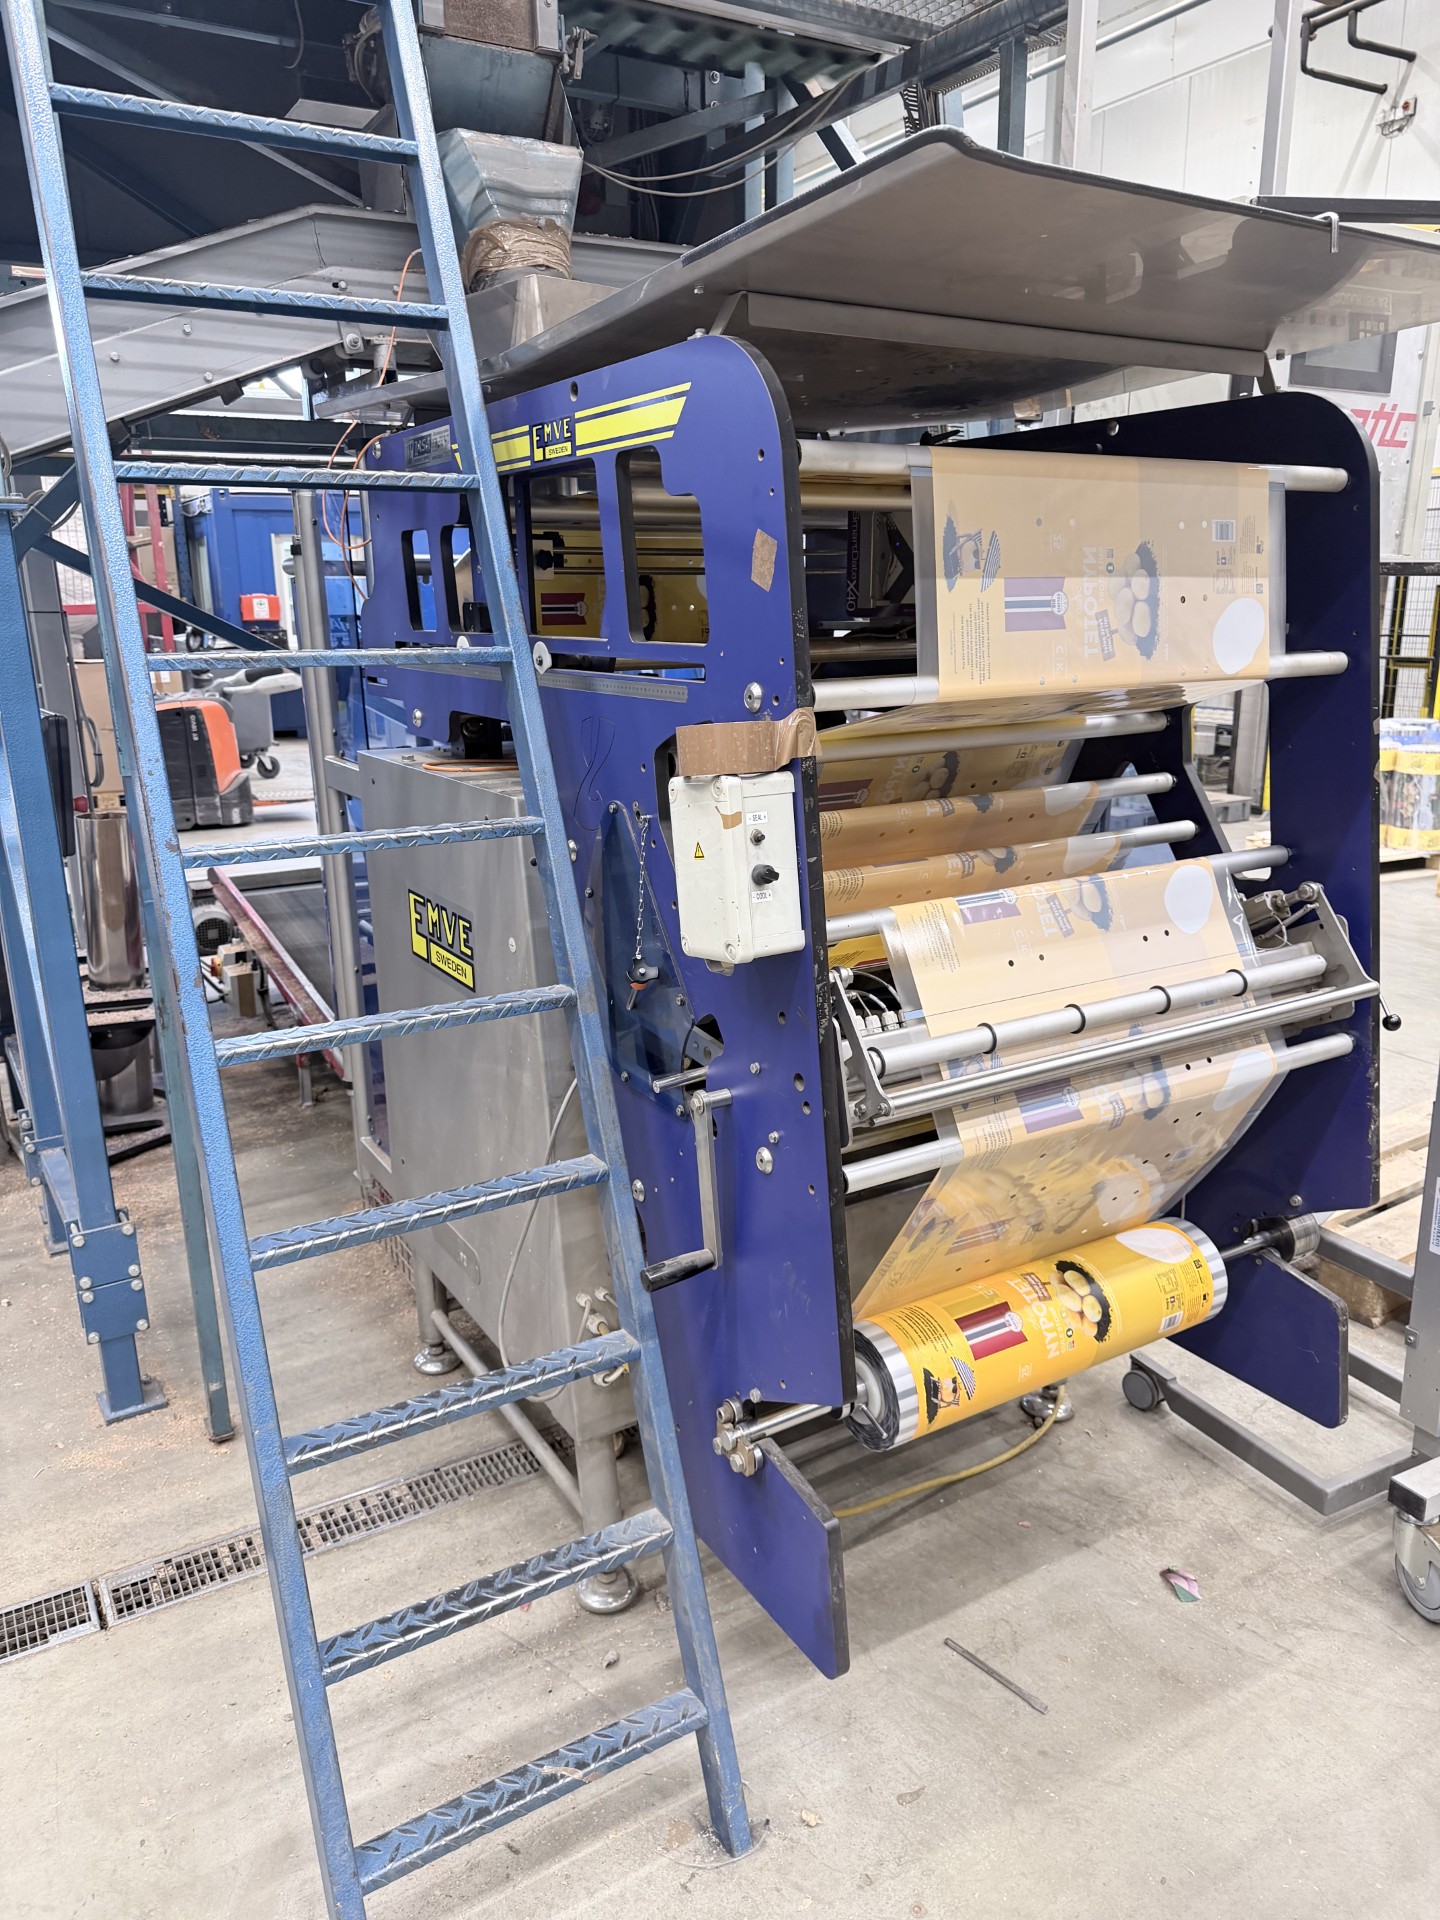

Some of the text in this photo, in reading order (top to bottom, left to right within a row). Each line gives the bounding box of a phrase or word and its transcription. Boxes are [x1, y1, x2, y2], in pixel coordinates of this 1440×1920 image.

[532, 417, 572, 462] EMVE
[548, 446, 568, 456] SWEDEN
[847, 579, 859, 612] X40
[408, 888, 475, 963] EMVE
[435, 950, 467, 979] SWEDEN
[1006, 1277, 1061, 1359] NYPOTET
